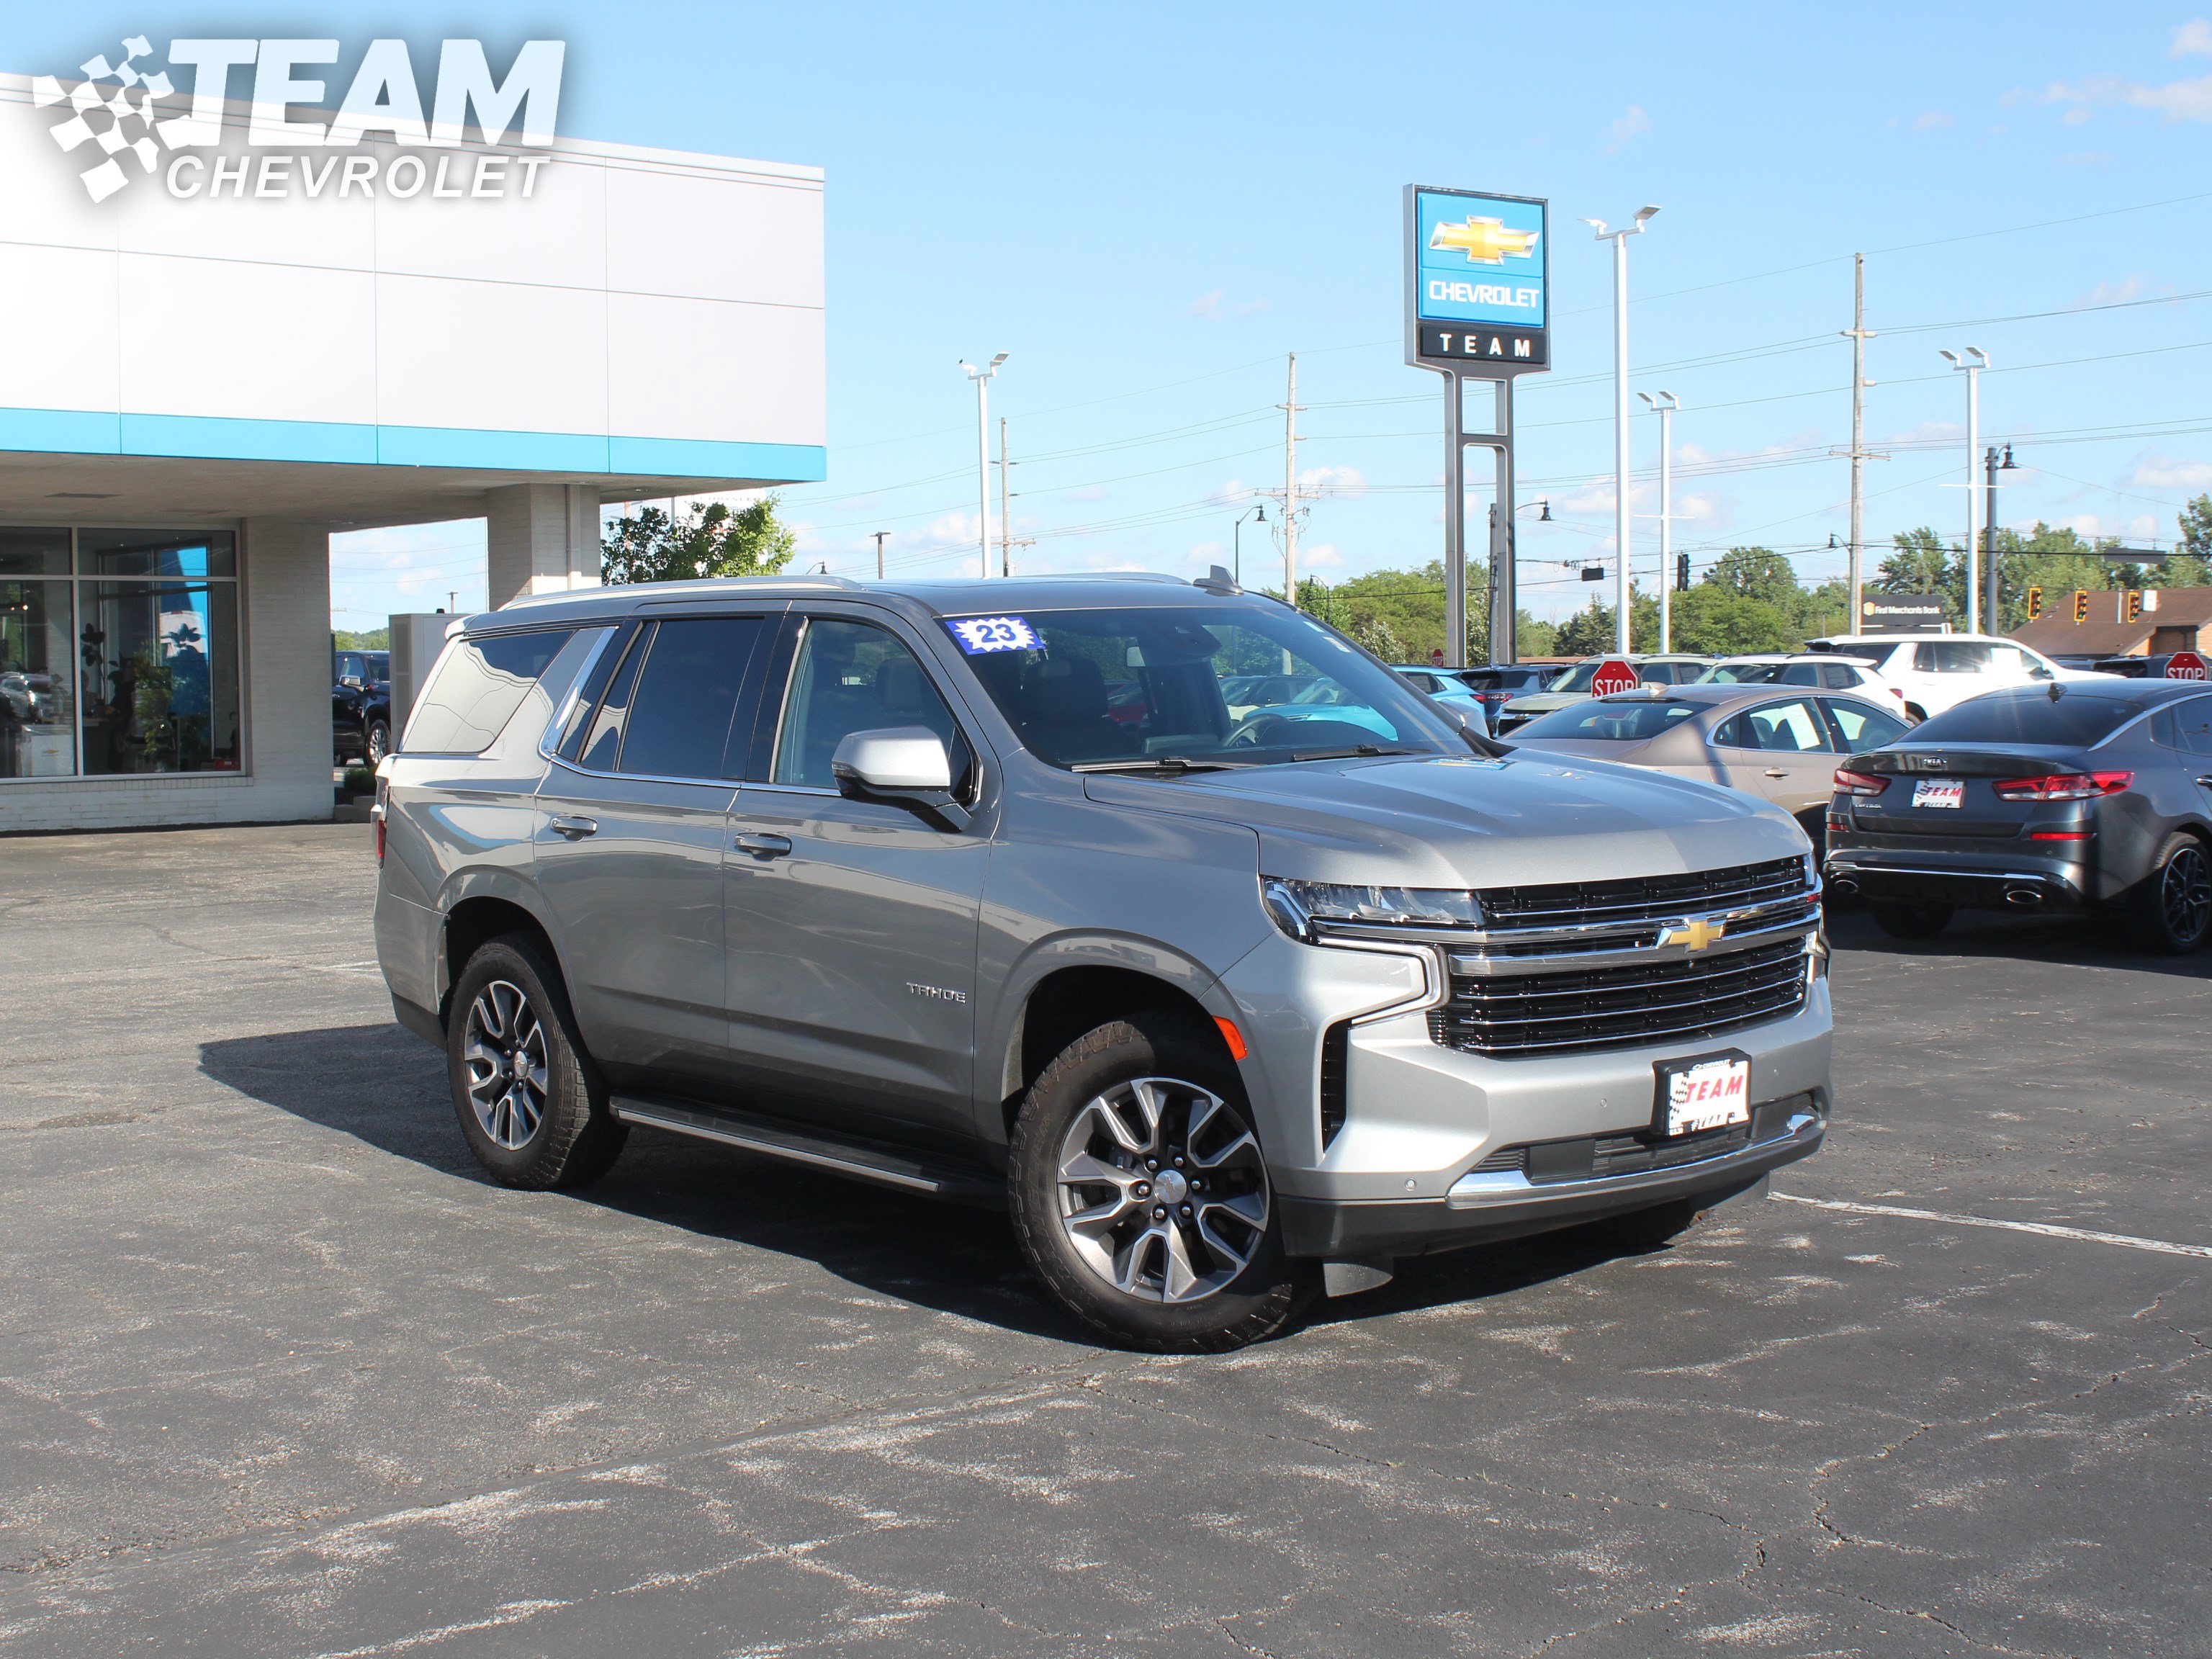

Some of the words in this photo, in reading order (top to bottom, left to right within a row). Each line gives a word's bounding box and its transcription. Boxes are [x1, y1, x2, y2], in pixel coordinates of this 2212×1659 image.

[1429, 280, 1539, 308] CHEVROLET
[1439, 333, 1531, 358] TEAM
[1875, 606, 1887, 614] First
[1888, 606, 1923, 614] Merchants
[1923, 606, 1941, 614] Bank
[976, 624, 1017, 643] 23
[2167, 667, 2204, 680] STOP
[1594, 678, 1635, 696] STOP
[1926, 787, 1961, 796] TEAM
[907, 982, 966, 1004] TAHOE
[1685, 1075, 1744, 1103] TEAM
